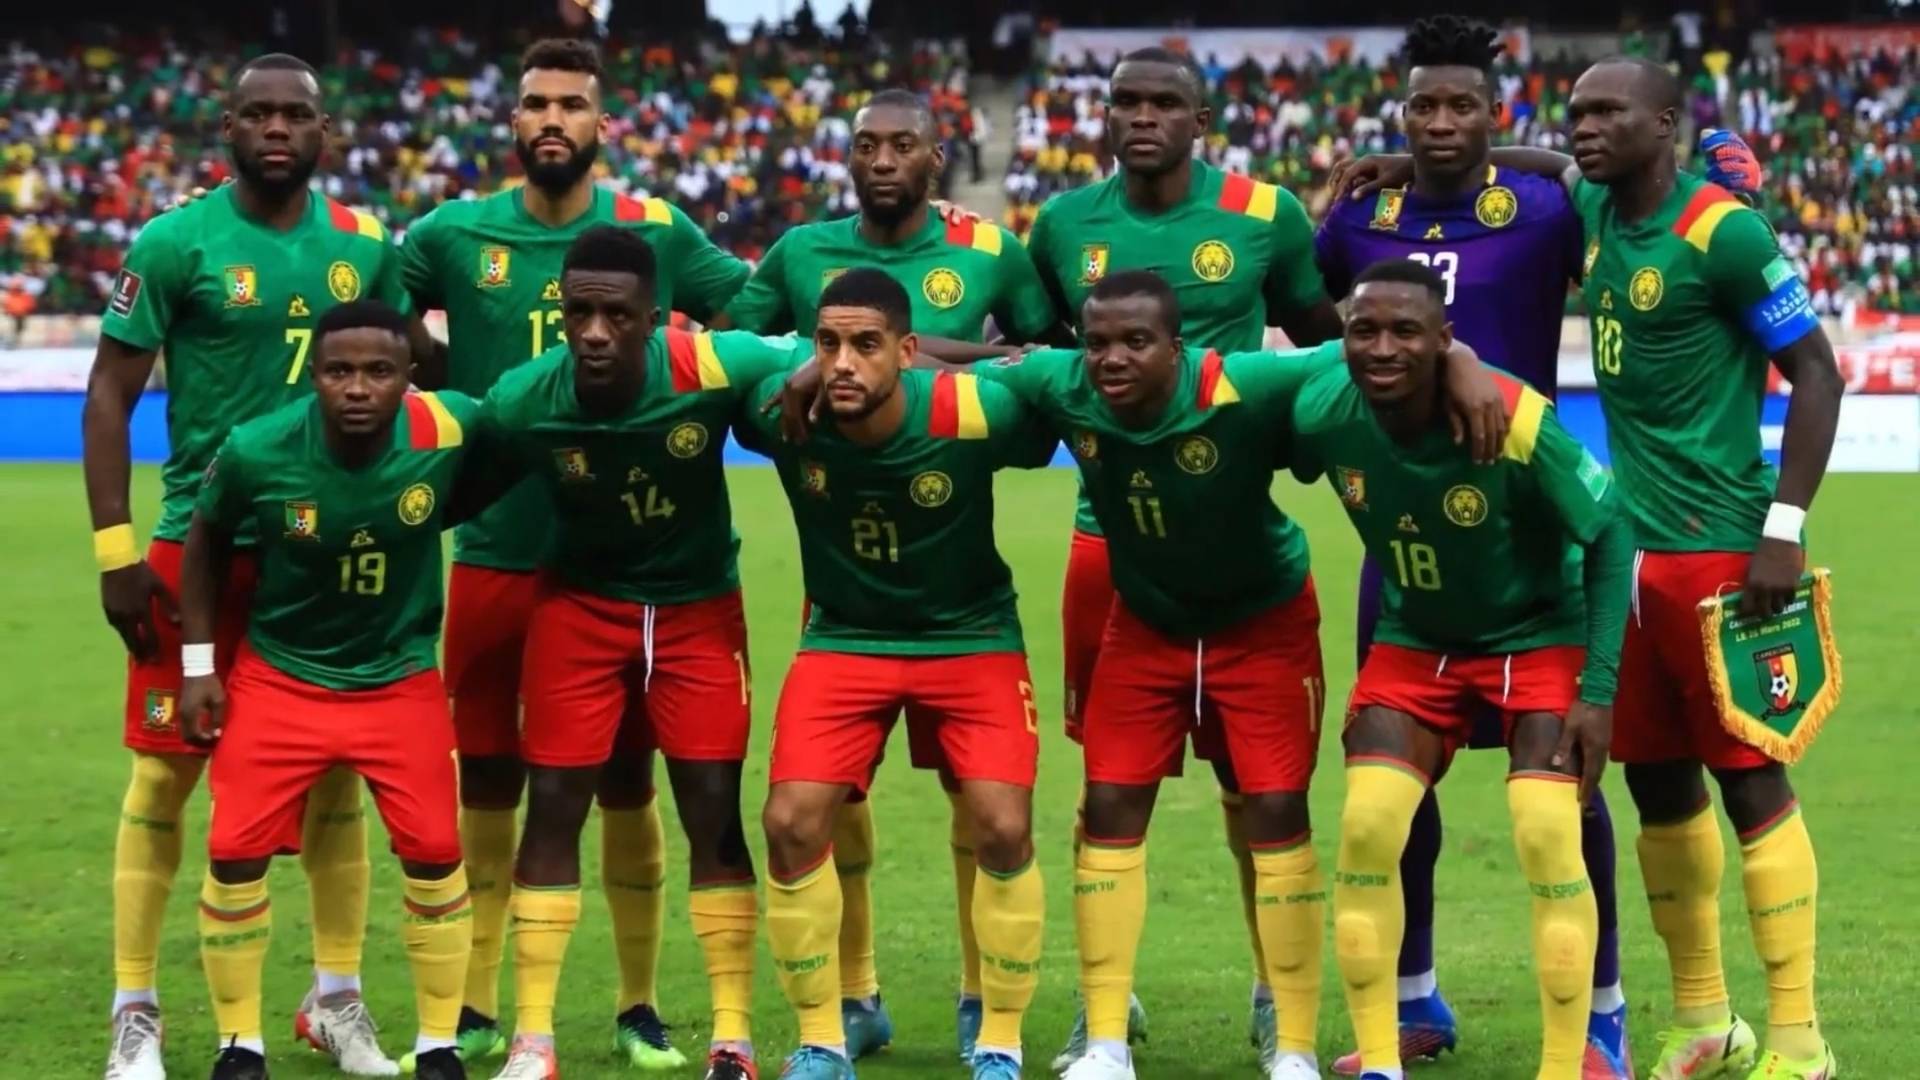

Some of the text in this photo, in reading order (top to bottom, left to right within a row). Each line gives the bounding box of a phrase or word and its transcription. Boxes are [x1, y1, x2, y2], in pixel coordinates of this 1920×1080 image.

[1407, 251, 1459, 306] 3
[286, 328, 313, 385] 7
[1596, 315, 1623, 376] 10
[620, 485, 677, 526] 14
[1127, 496, 1167, 538] 11
[851, 517, 899, 563] 21
[336, 551, 387, 596] 19
[1389, 539, 1442, 591] 18
